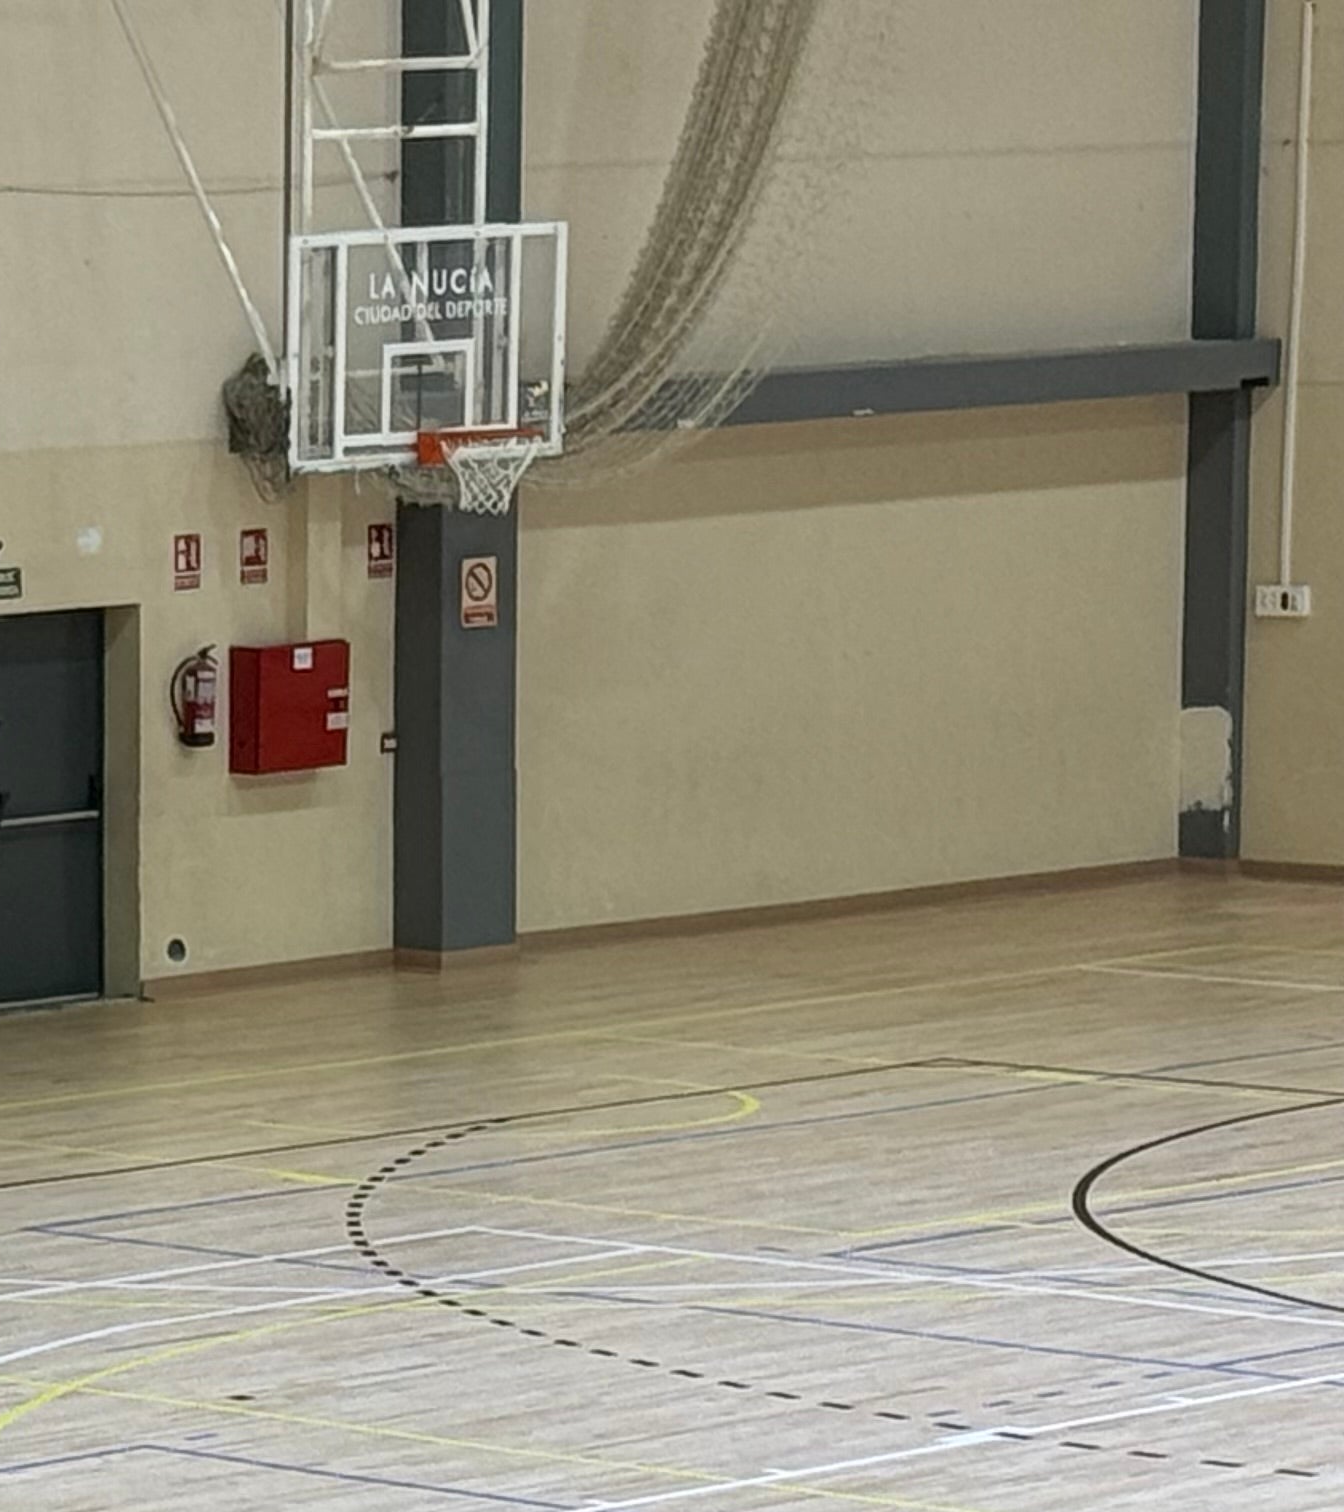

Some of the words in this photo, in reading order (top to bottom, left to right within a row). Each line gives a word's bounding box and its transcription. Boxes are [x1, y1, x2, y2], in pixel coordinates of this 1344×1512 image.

[369, 271, 396, 300] LA
[354, 302, 413, 326] CIUDAD
[414, 300, 443, 322] DEL
[445, 296, 508, 320] DEPORTE
